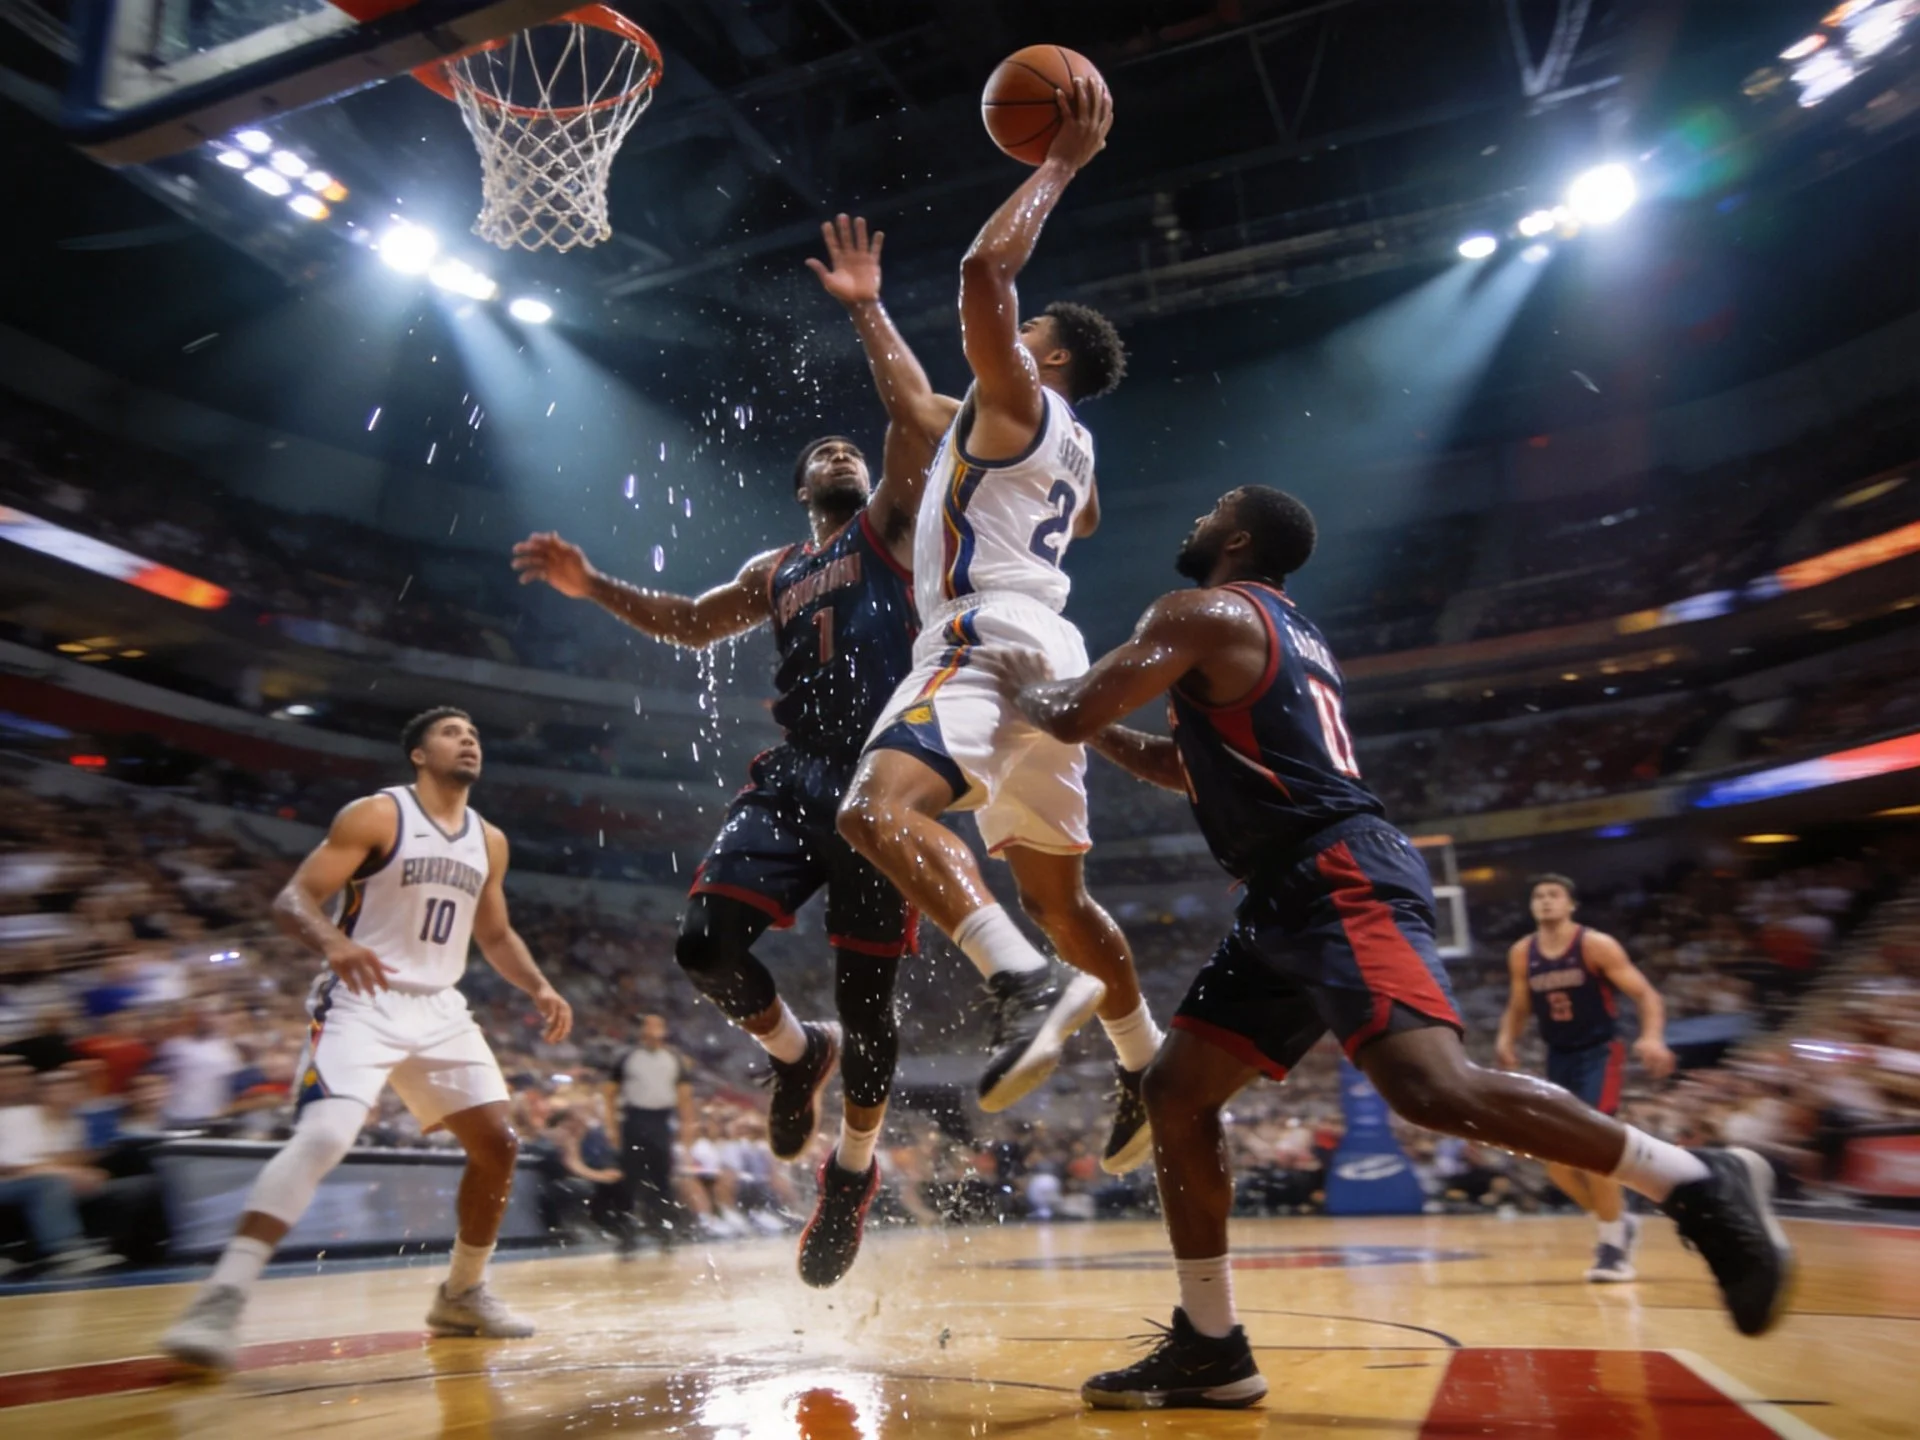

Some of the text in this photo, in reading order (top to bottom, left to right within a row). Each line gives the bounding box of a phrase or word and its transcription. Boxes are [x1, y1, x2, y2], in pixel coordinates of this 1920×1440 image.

[1028, 479, 1076, 568] 2
[811, 606, 834, 663] 1
[419, 898, 456, 945] 10
